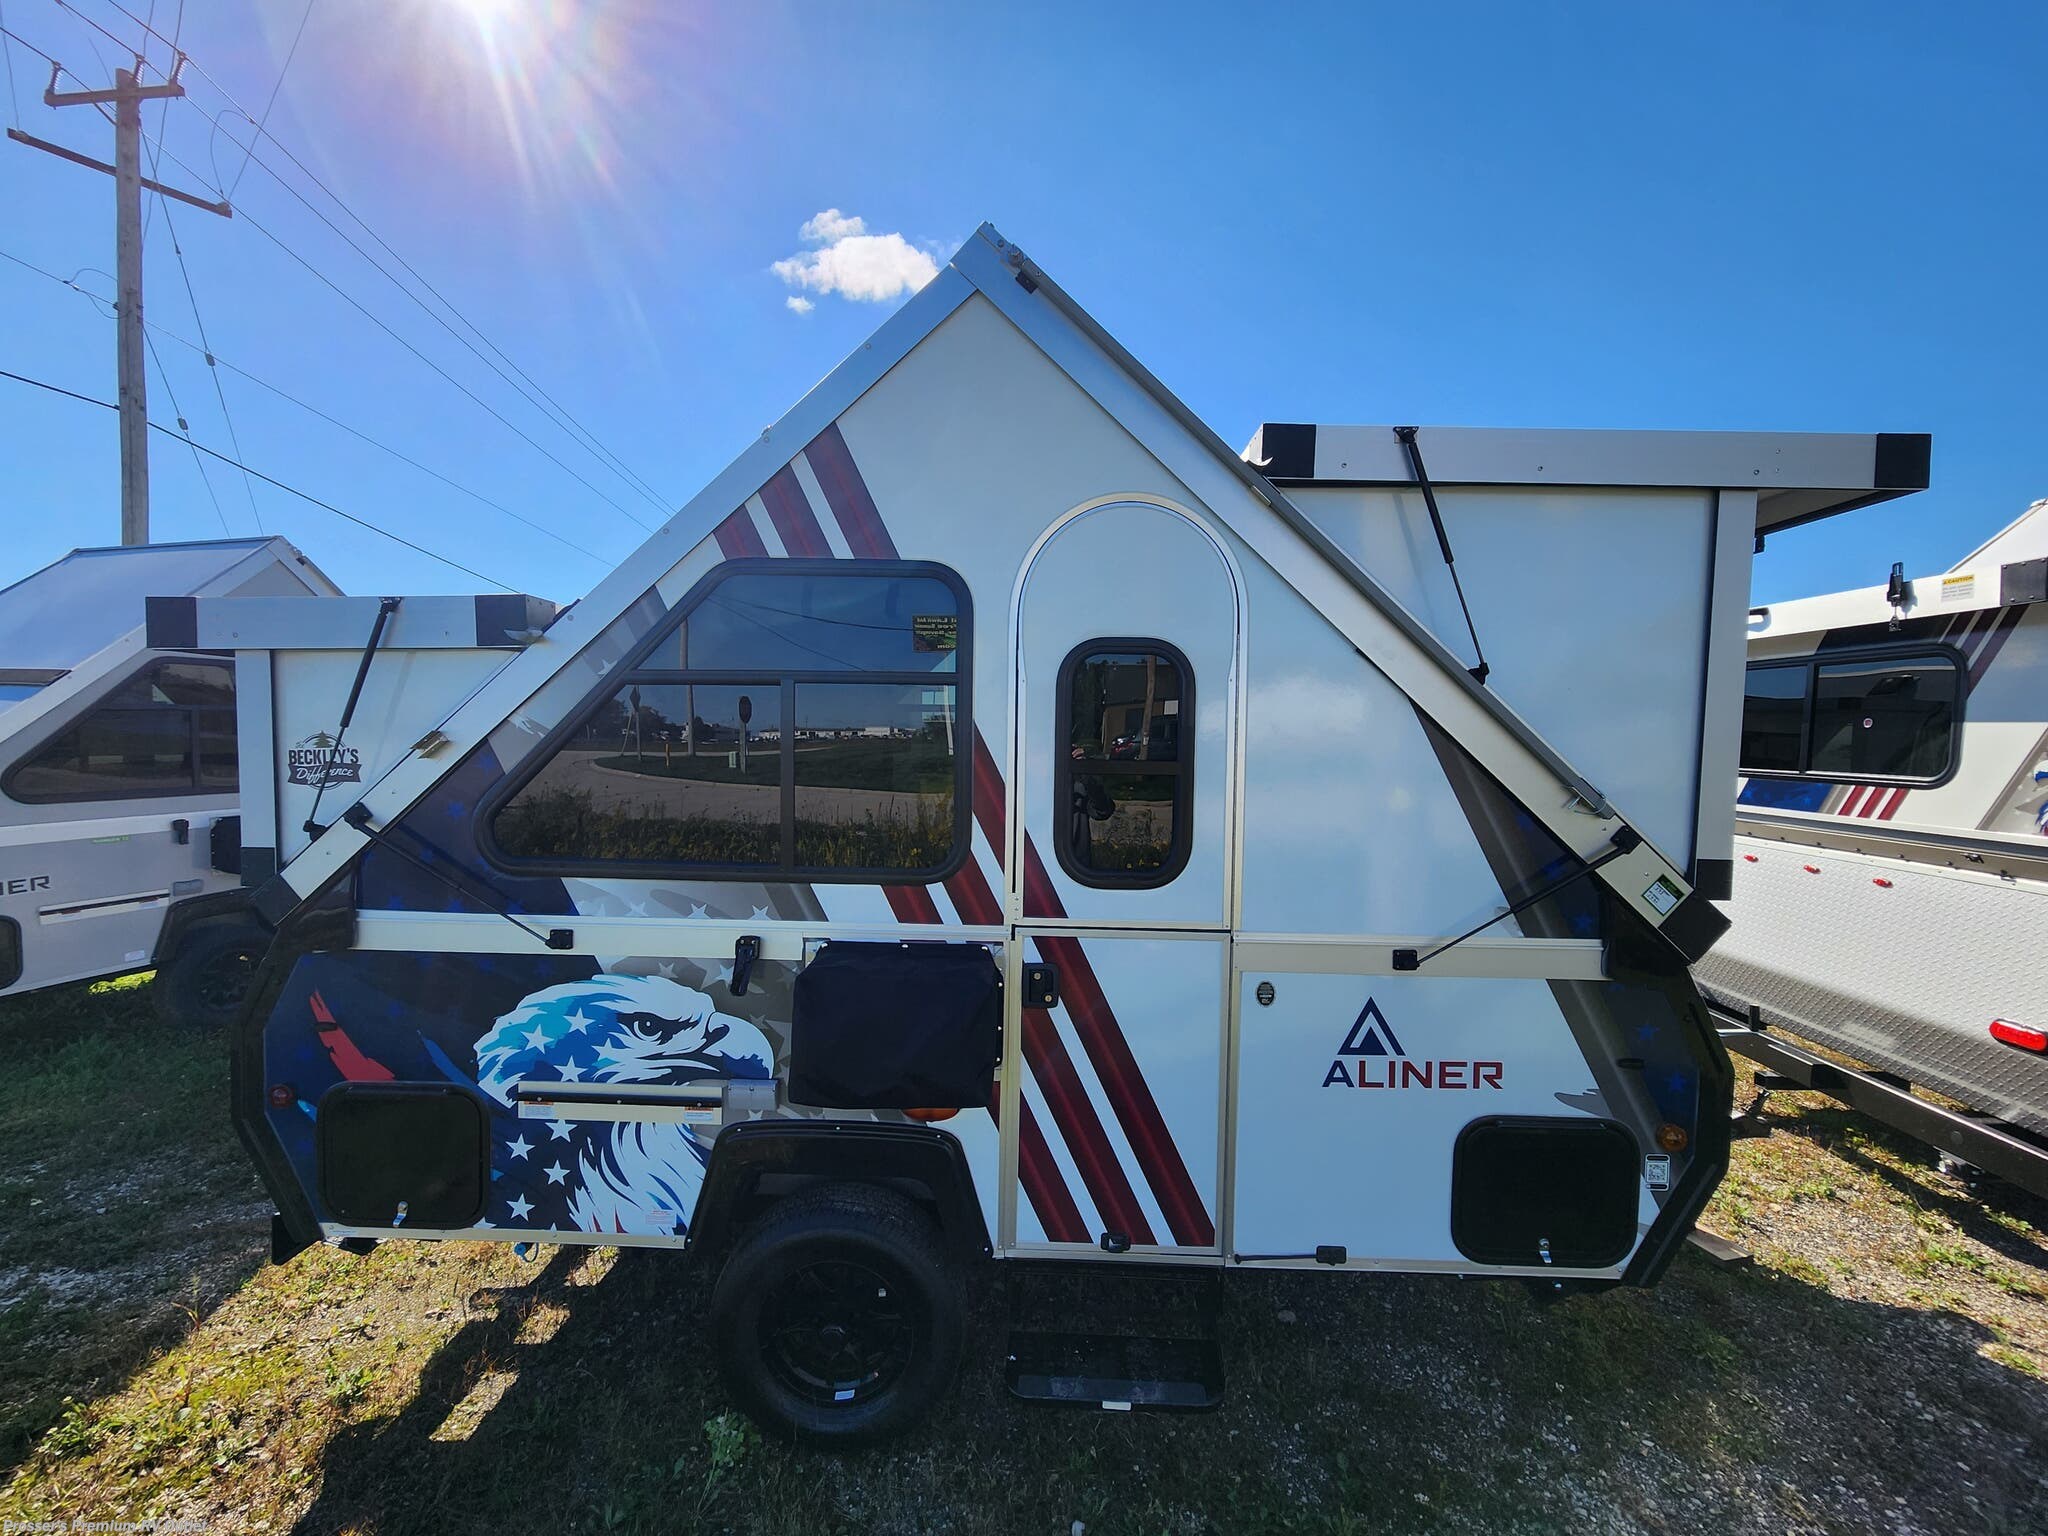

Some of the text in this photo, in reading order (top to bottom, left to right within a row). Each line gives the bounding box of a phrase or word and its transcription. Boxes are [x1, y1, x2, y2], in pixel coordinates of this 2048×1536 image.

[296, 766, 354, 783] Diffeence
[0, 875, 51, 896] ER
[1321, 1060, 1504, 1090] ALINER
